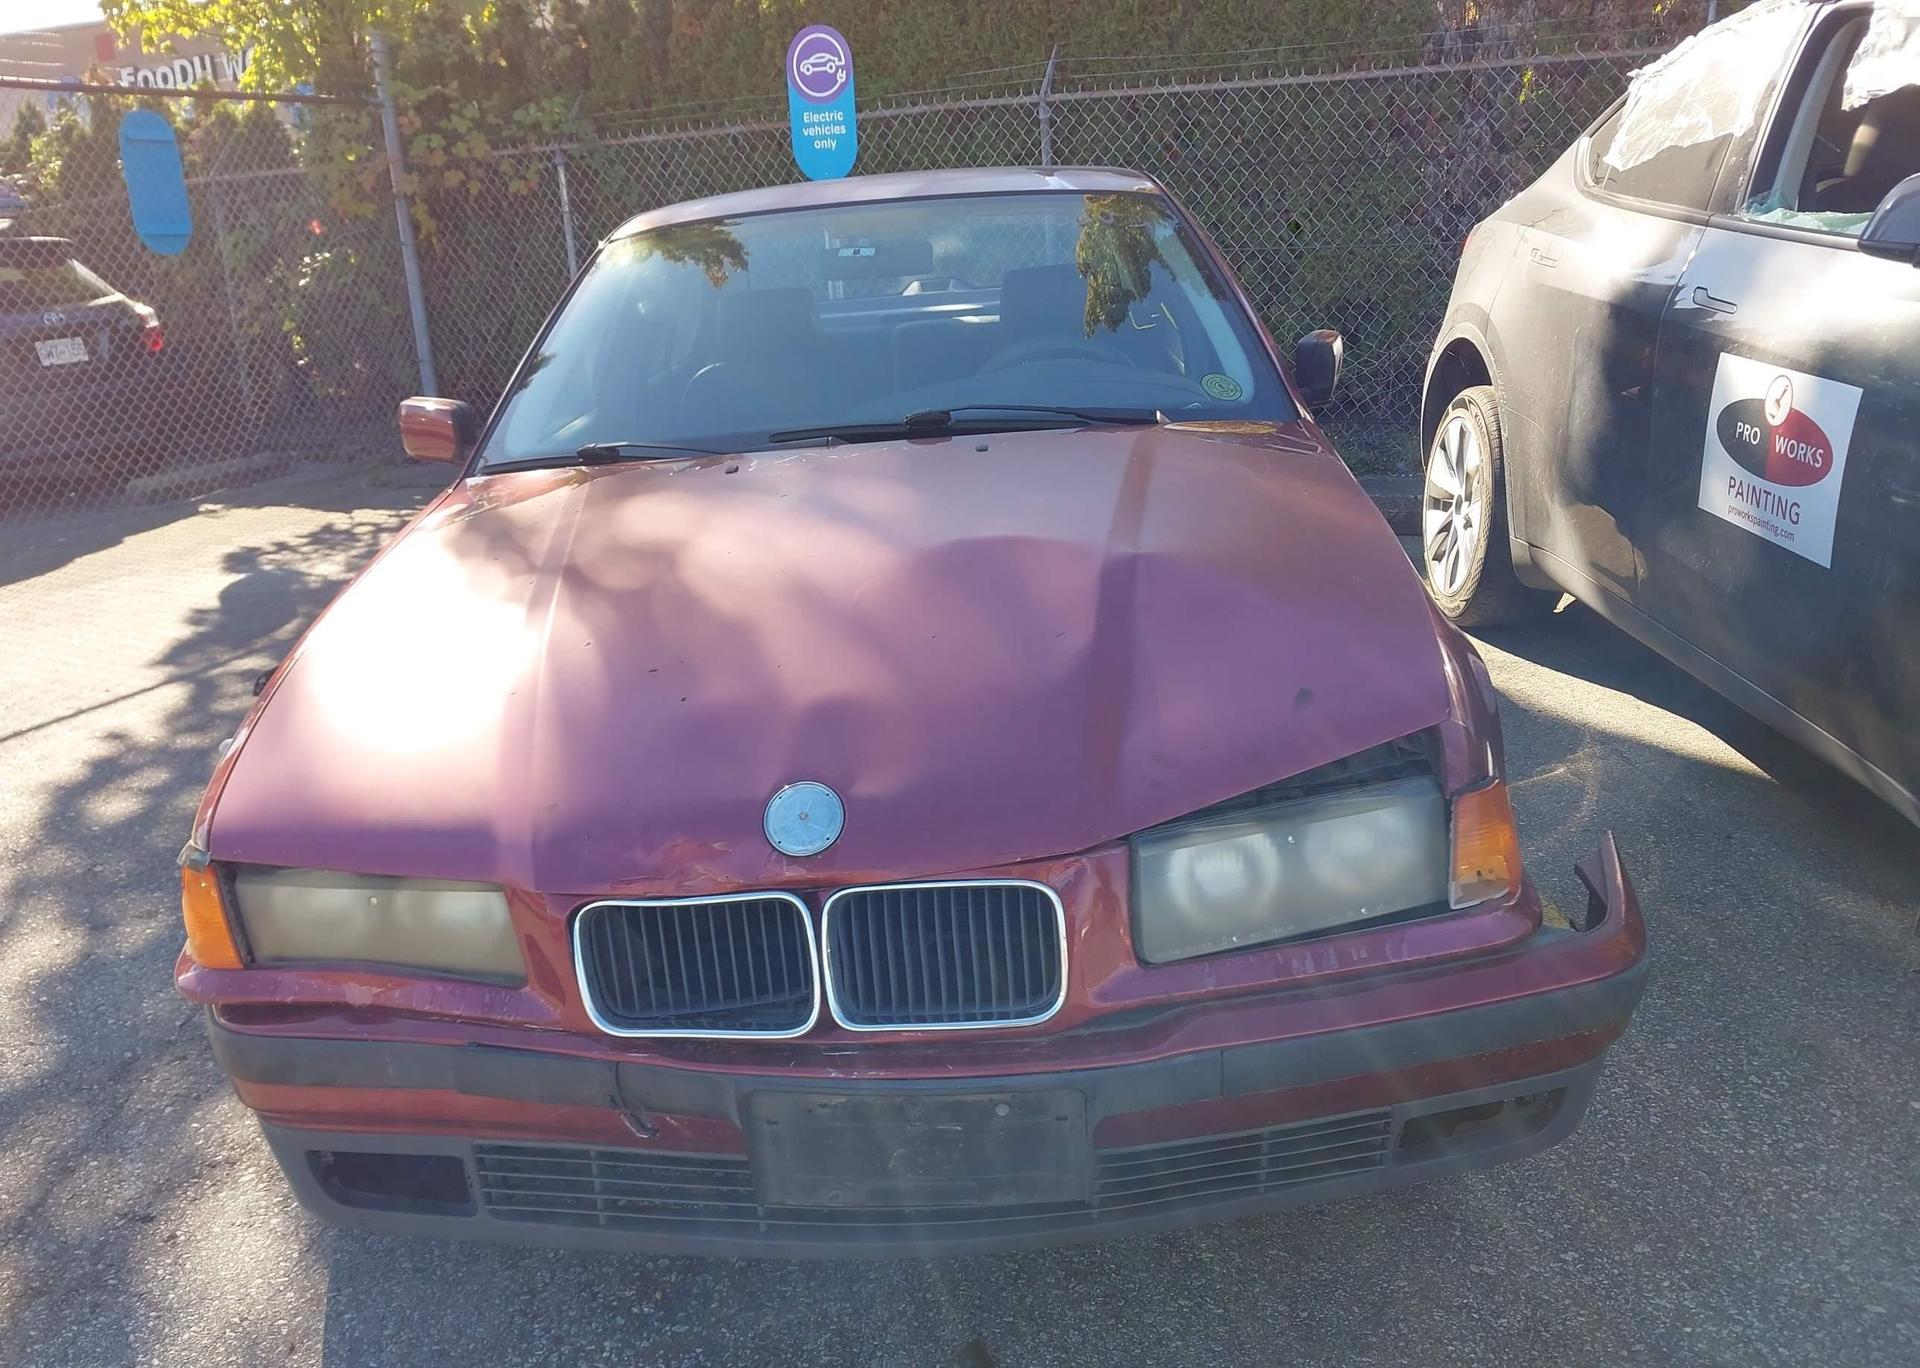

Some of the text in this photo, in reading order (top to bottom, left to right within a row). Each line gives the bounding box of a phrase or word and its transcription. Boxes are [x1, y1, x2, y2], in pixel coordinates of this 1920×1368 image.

[803, 110, 844, 123] Electric
[802, 124, 846, 136] vehicles
[814, 138, 837, 150] only
[1735, 421, 1824, 468] PRO WORKS
[1727, 476, 1801, 525] PAINTING
[1727, 504, 1795, 542] proworkspainting.com
